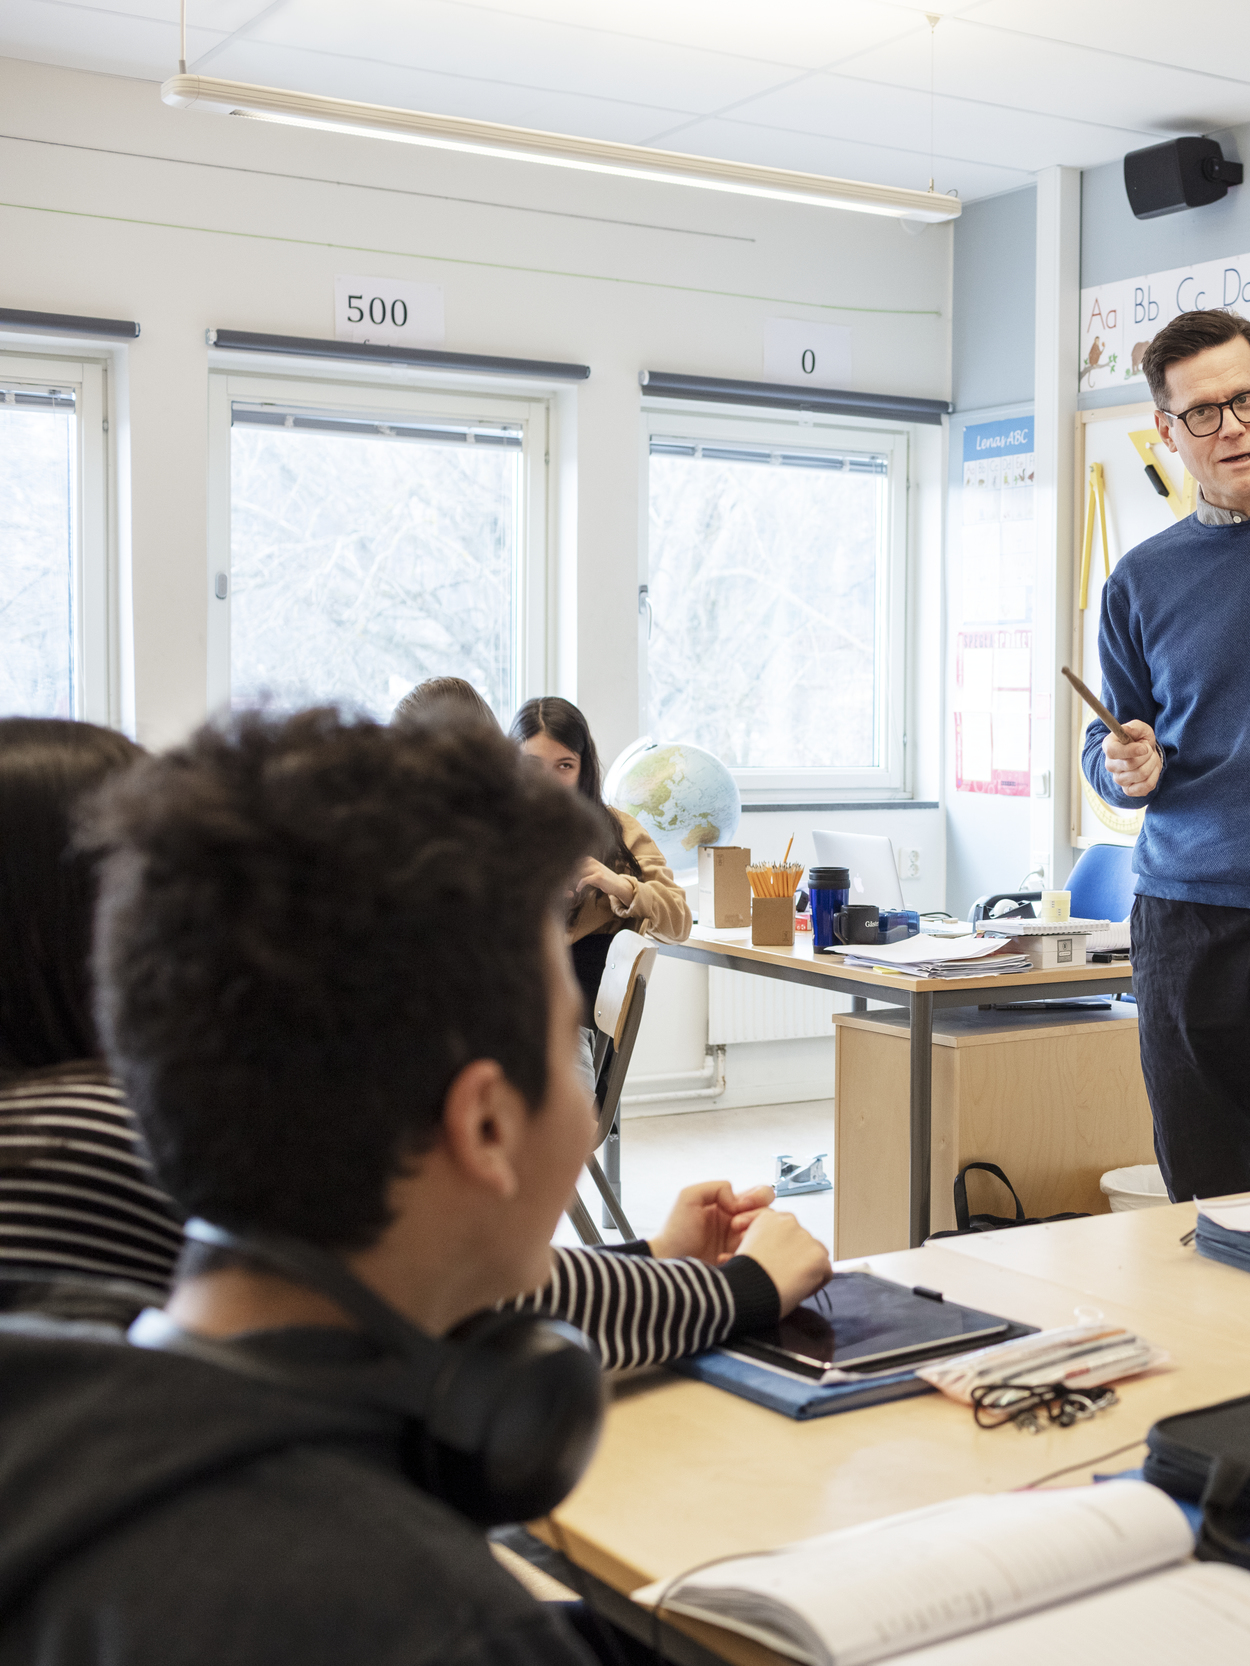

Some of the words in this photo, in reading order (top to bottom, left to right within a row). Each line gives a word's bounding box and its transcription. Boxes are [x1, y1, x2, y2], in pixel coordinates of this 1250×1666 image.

[347, 294, 408, 327] 500
[1086, 297, 1117, 333] Aa
[1134, 286, 1159, 324] Bb
[1175, 277, 1206, 314] Cc
[801, 349, 816, 374] 0
[976, 435, 1005, 451] Lenas
[1006, 429, 1028, 446] ABC
